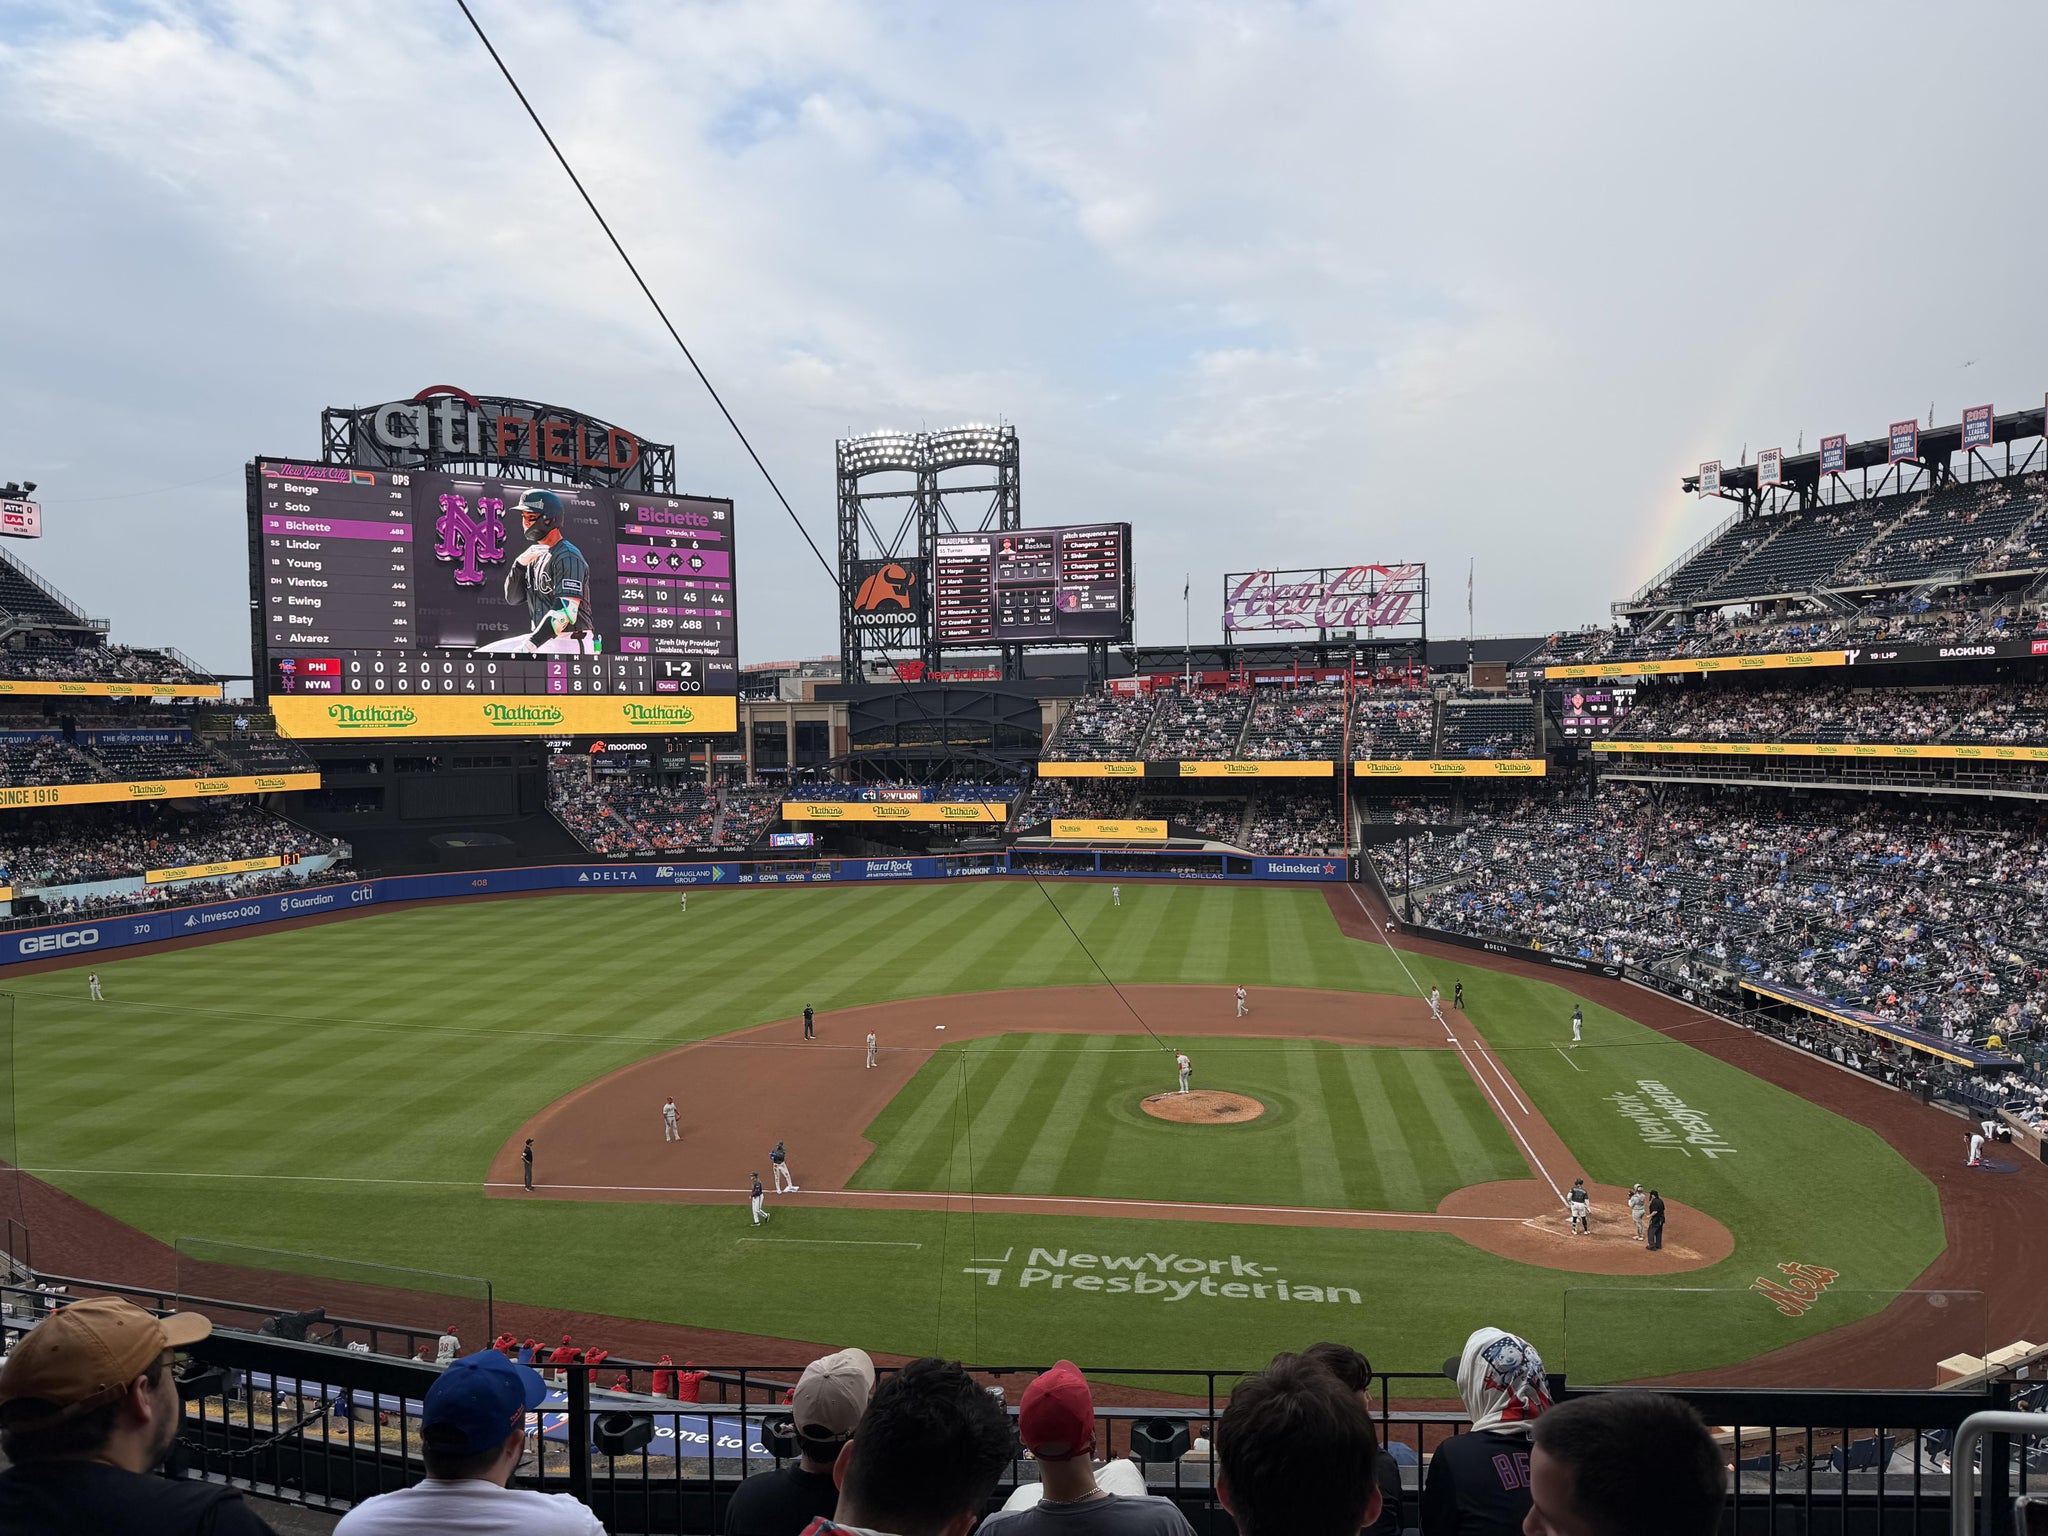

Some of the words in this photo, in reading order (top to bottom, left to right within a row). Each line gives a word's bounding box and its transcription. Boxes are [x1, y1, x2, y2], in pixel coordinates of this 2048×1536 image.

[1966, 408, 1988, 422] 2015
[374, 391, 480, 455] citi
[496, 415, 639, 470] FIELD
[1892, 423, 1913, 436] 2000
[1966, 421, 1988, 430] NATIONAL
[1893, 435, 1912, 443] NATIONAL
[1964, 434, 1989, 443] CHAMPIONS
[1761, 451, 1777, 463] 1986
[1891, 447, 1914, 455] CHAMPIONS
[1702, 464, 1718, 474] 1969
[392, 474, 409, 486] OPS
[284, 483, 319, 496] Benge
[5, 504, 22, 512] ATH
[285, 502, 310, 512] Soto
[619, 502, 629, 511] 19
[5, 515, 22, 523] LAA
[637, 506, 709, 526] Bichette
[712, 511, 725, 520] 3B
[285, 520, 331, 532] Bichette
[665, 529, 688, 537] Orlando,
[286, 540, 320, 550] Lindor
[670, 539, 677, 547] 3
[692, 541, 698, 549] 6
[286, 558, 322, 571] Young
[621, 555, 636, 564] 1-3
[646, 555, 658, 564] L6
[671, 558, 678, 566] K
[691, 559, 701, 567] 1B
[287, 577, 328, 588] Vientos
[288, 596, 321, 608] Ewing
[622, 590, 644, 599] .254
[656, 591, 667, 600] 10
[683, 593, 697, 602] 45
[711, 594, 724, 603] 44
[1224, 563, 1424, 631] Coca-Cola
[288, 615, 313, 626] Baty
[623, 618, 645, 627] .299
[652, 619, 673, 628] .389
[680, 620, 702, 629] .688
[854, 612, 916, 625] moomoo
[477, 622, 509, 631] mets
[289, 633, 329, 643] Alvarez
[676, 639, 688, 647] (My
[1939, 646, 1996, 657] BACKHUS
[308, 663, 326, 671] PHI
[351, 662, 360, 673] 0
[374, 662, 384, 673] 0
[398, 662, 407, 673] 2
[421, 662, 430, 673] 0
[443, 662, 452, 673] 0
[466, 663, 474, 673] 0
[488, 663, 496, 674] 0
[553, 664, 561, 675] 2
[573, 665, 581, 675] 5
[592, 665, 600, 675] 0
[618, 666, 625, 675] 3
[665, 661, 691, 676] 1-2
[928, 671, 949, 680] new
[954, 669, 1002, 679] balance
[305, 681, 330, 689] NYM
[351, 679, 361, 690] 0
[375, 679, 384, 690] 0
[398, 679, 407, 690] 0
[421, 679, 430, 690] 0
[444, 679, 453, 690] 0
[466, 680, 475, 690] 4
[490, 680, 495, 690] 1
[554, 680, 561, 690] 5
[573, 680, 582, 691] 8
[593, 680, 601, 691] 0
[618, 681, 626, 691] 4
[328, 703, 418, 724] Nathan's
[483, 703, 565, 723] Nathan's
[623, 703, 695, 722] Nathan's
[132, 734, 153, 742] PORCH
[608, 742, 647, 751] moomoo
[194, 780, 230, 793] Nathan's
[254, 777, 286, 790] Nathan's
[32, 788, 59, 803] 1916
[129, 783, 168, 797] Nathan's
[806, 805, 844, 817] Nathan's
[872, 805, 911, 817] Nathan's
[940, 805, 980, 818] Nathan's
[866, 861, 888, 871] Hard
[889, 860, 912, 871] Rock
[1268, 862, 1321, 874] Heineken
[593, 871, 637, 880] DELTA
[674, 870, 710, 878] HAUGLAND
[739, 875, 752, 883] 380
[759, 874, 778, 882] GOYA
[812, 872, 831, 880] GOYA
[471, 879, 488, 887] 408
[290, 894, 333, 909] Guardian
[201, 909, 239, 924] Invesco
[240, 905, 260, 917] QQQ
[134, 924, 150, 935] 370
[19, 929, 99, 954] GEICO
[1489, 943, 1507, 952] DELTA
[1028, 1247, 1278, 1277] NewYork-
[1019, 1268, 1362, 1304] Presbyterian
[1749, 1261, 1839, 1316] Mets
